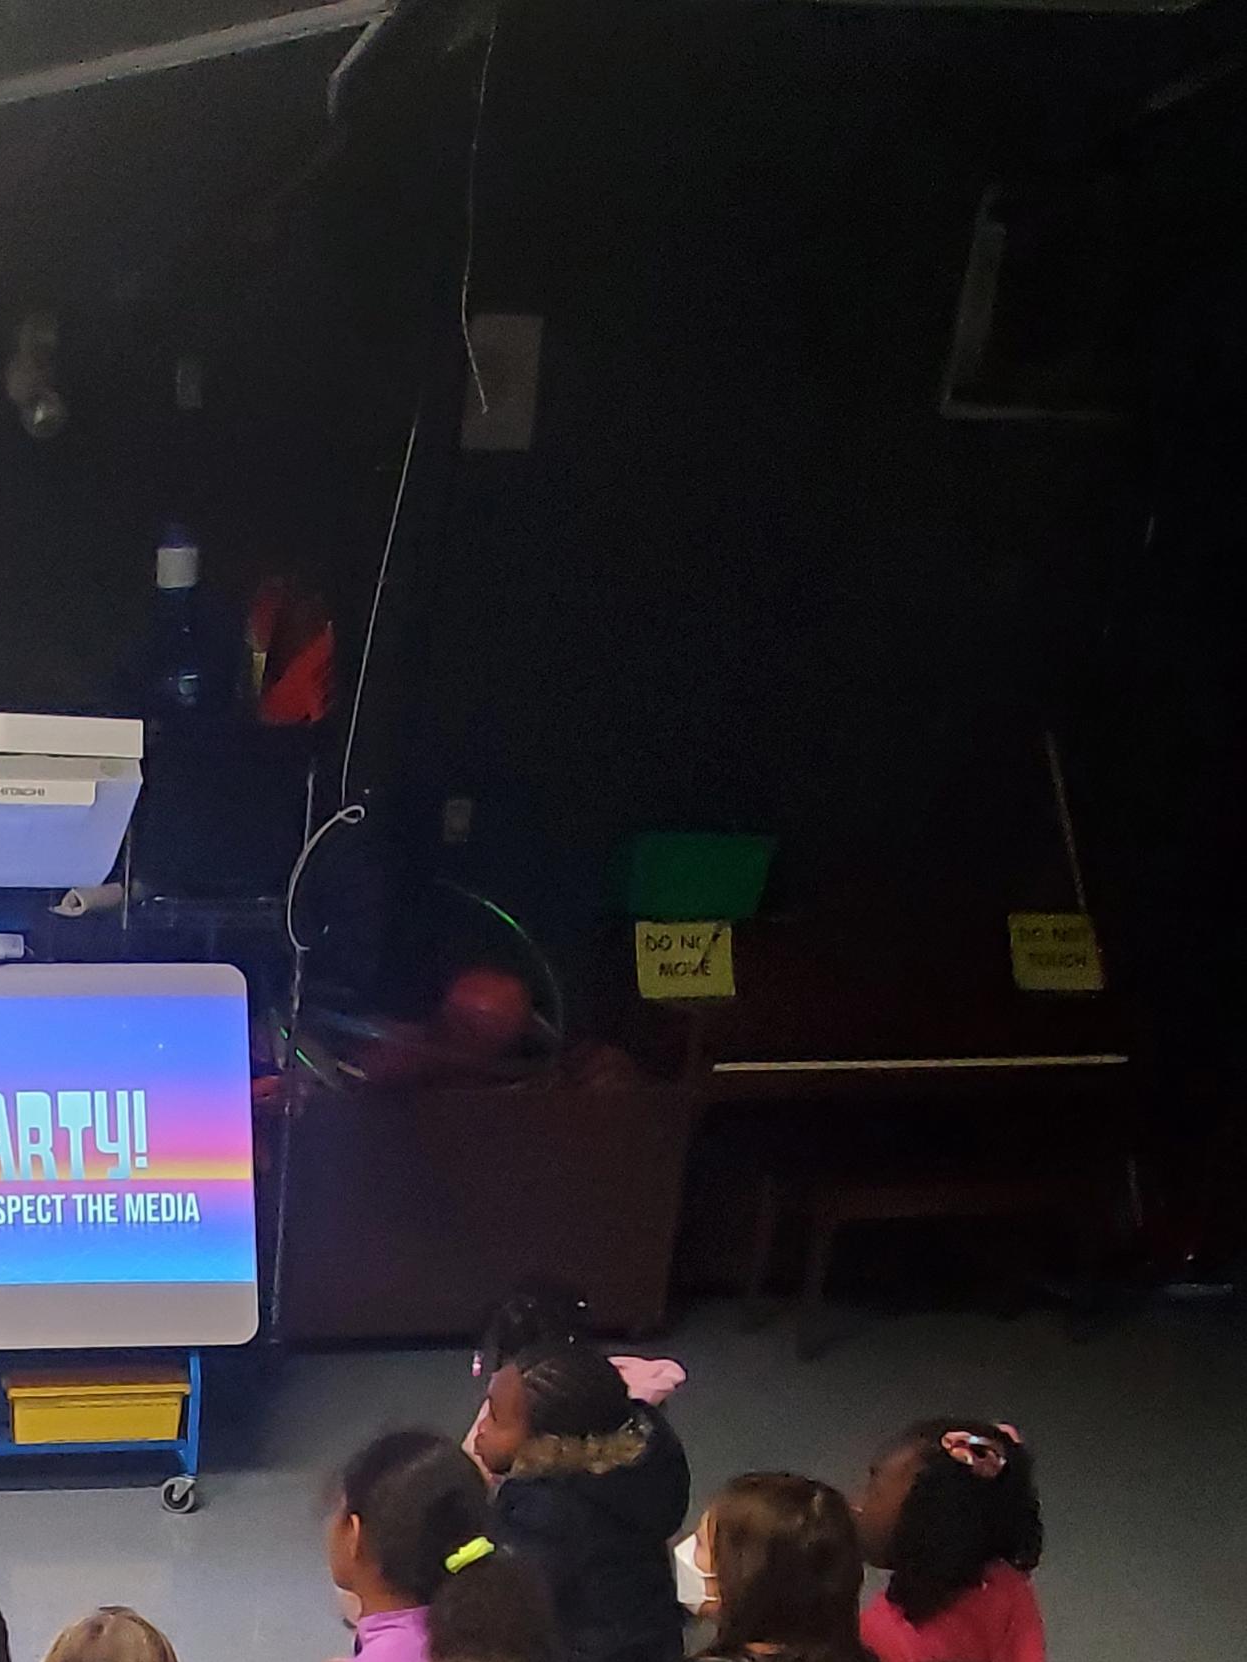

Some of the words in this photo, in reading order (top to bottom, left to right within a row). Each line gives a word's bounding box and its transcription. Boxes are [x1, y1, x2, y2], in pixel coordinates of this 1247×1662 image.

[645, 934, 673, 952] DO
[71, 1193, 118, 1223] THE
[124, 1192, 201, 1223] MEDIA
